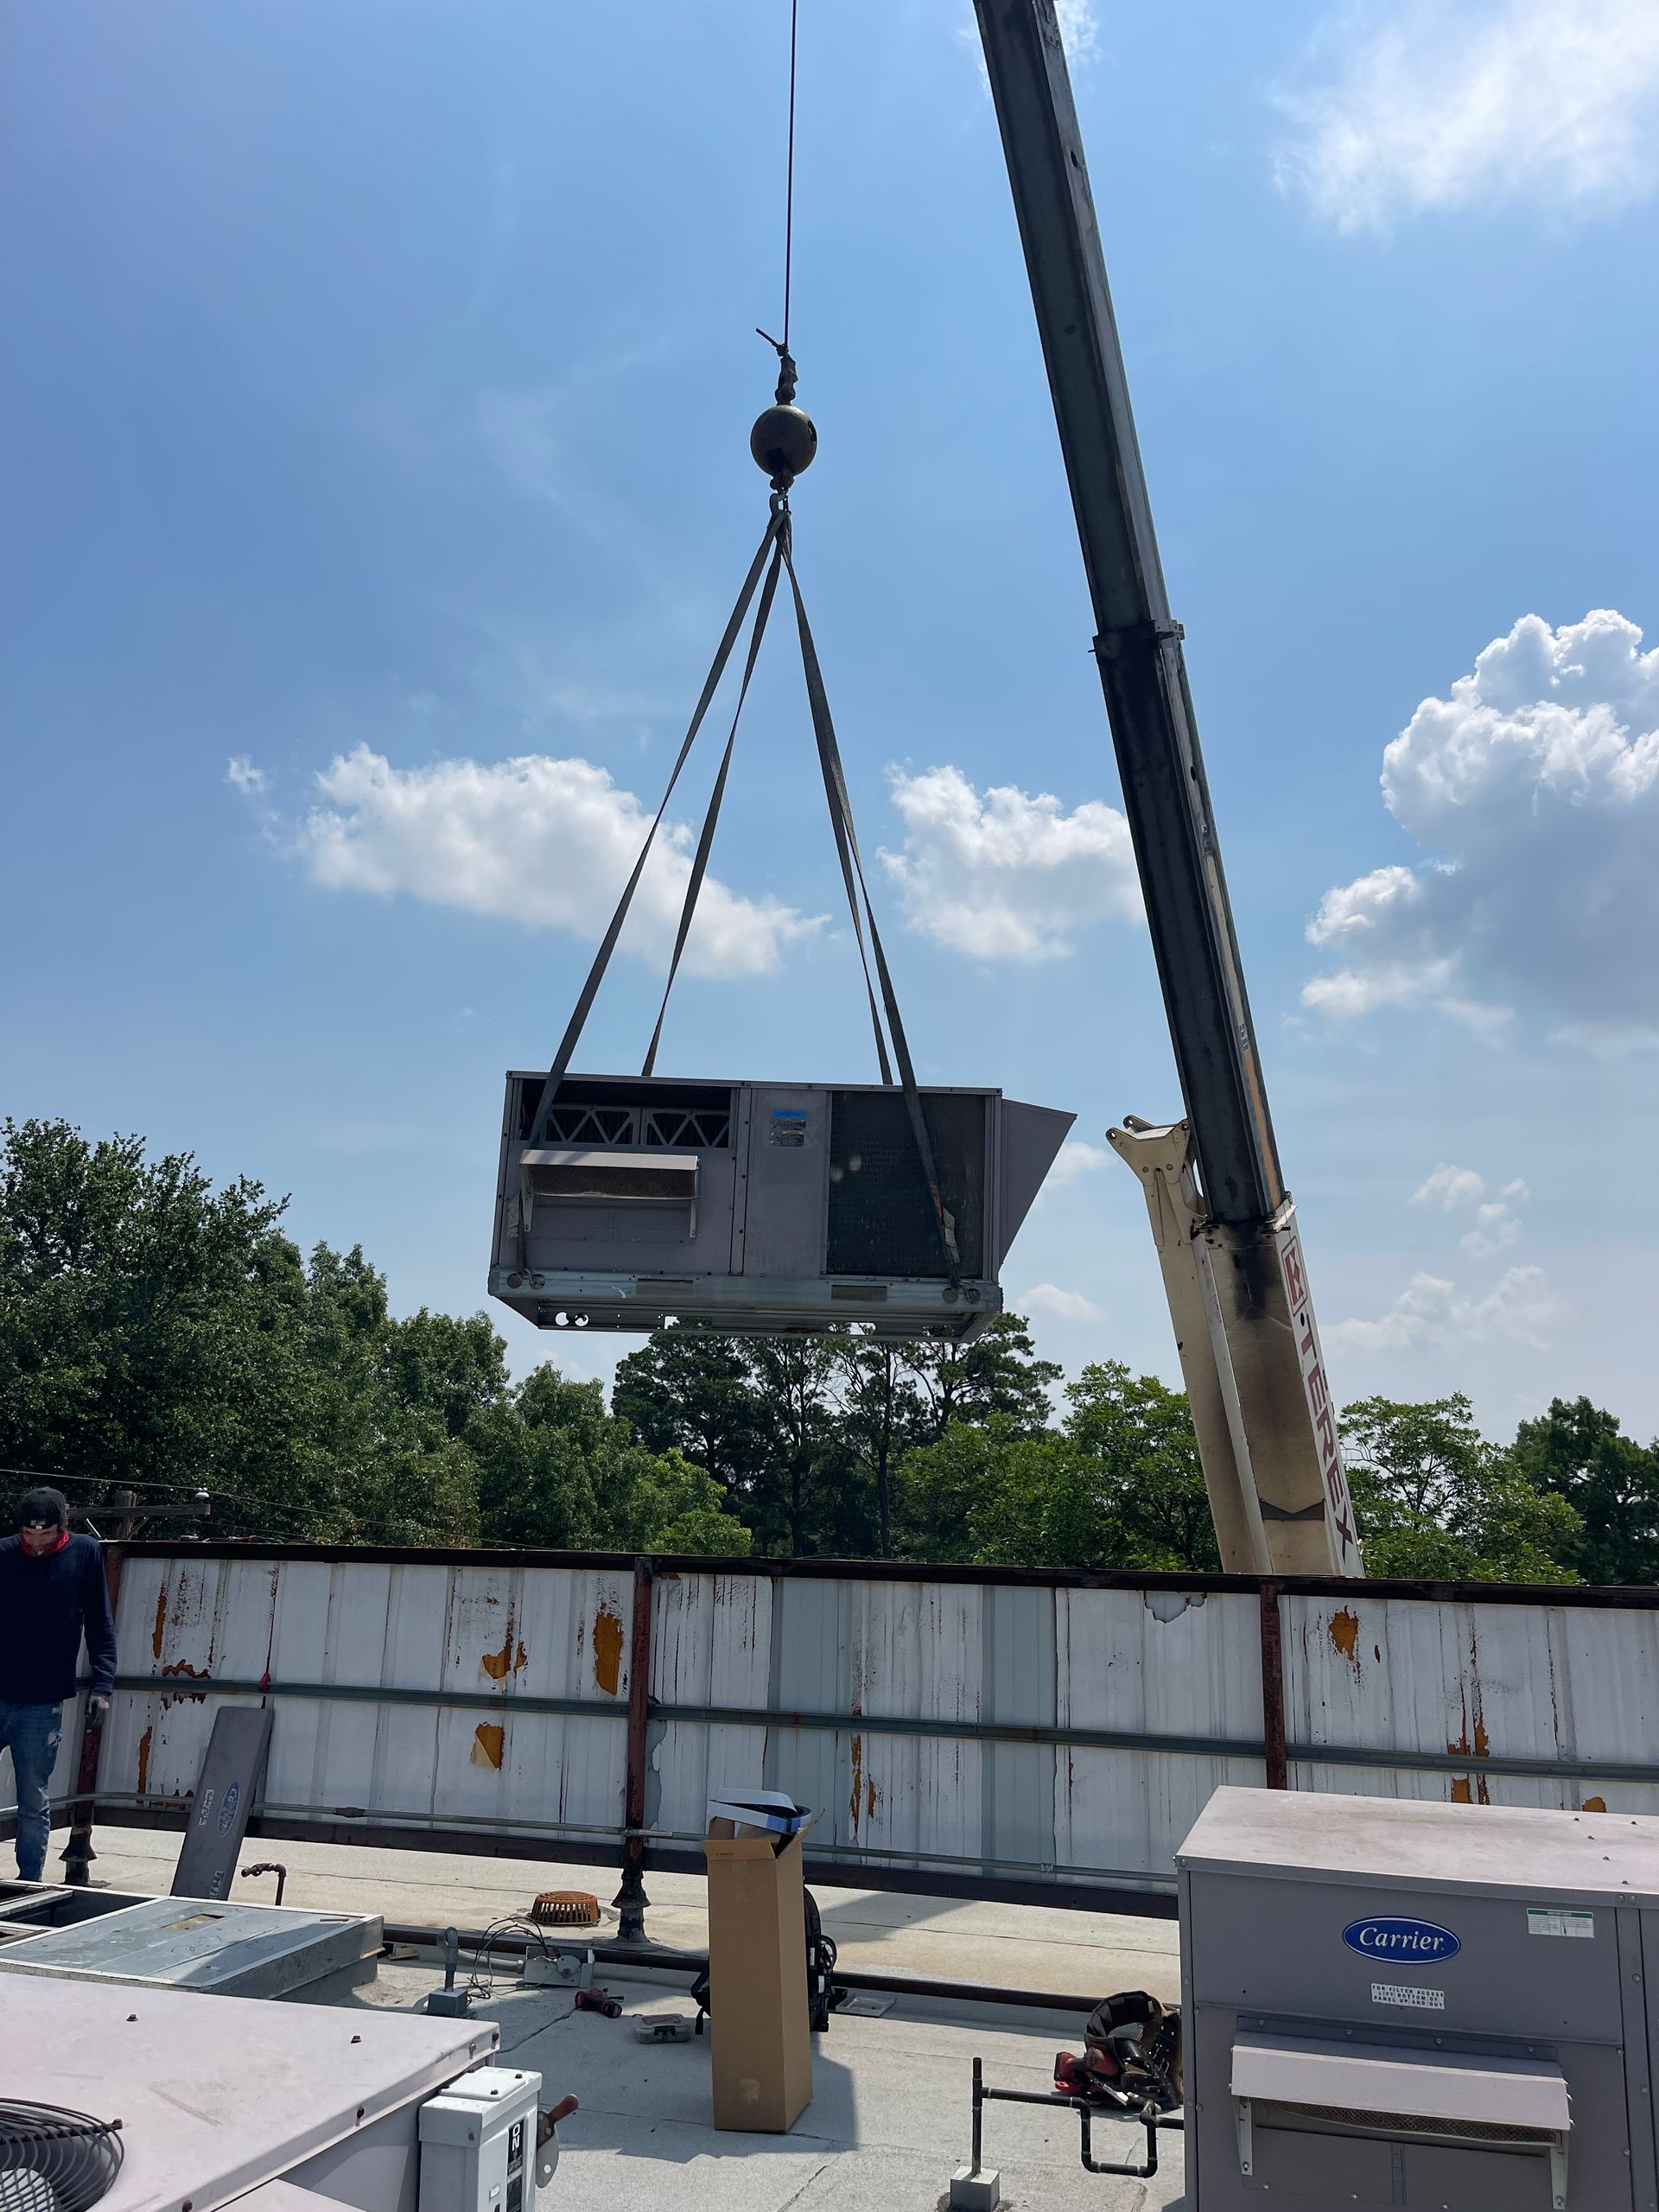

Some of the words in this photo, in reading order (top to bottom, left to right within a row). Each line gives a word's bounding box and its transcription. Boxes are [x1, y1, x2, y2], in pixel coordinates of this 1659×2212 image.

[1301, 1313, 1354, 1564] TEREX
[1359, 1927, 1444, 1950] Carrier
[512, 2123, 520, 2152] ON
